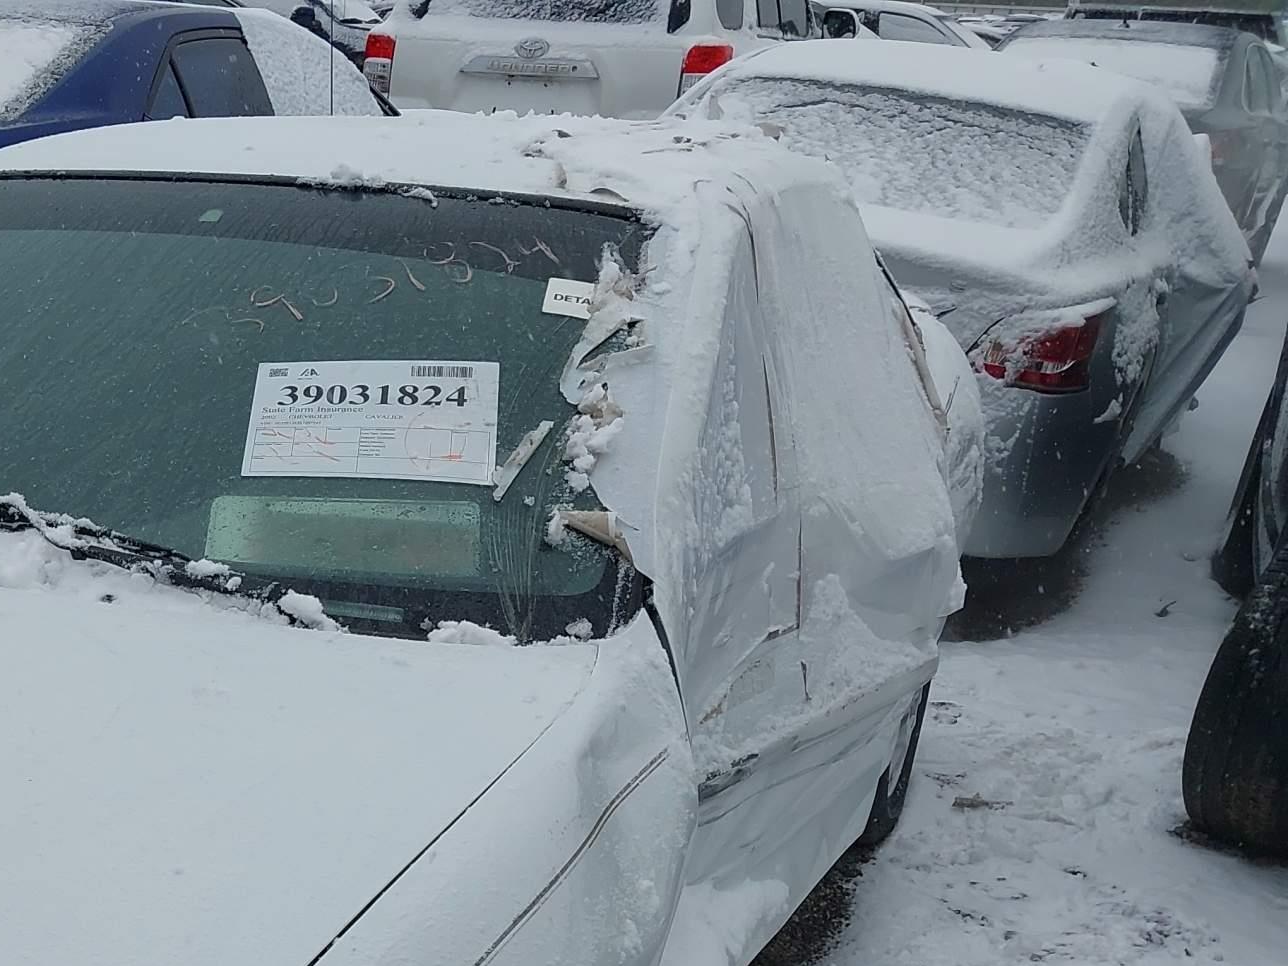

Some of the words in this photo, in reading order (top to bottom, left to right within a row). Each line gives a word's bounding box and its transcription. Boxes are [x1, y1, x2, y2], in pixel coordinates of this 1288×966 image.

[553, 293, 591, 306] DETA
[277, 384, 468, 407] 39031824
[262, 406, 286, 414] State
[288, 406, 314, 414] Farm
[317, 406, 364, 414] Insurance
